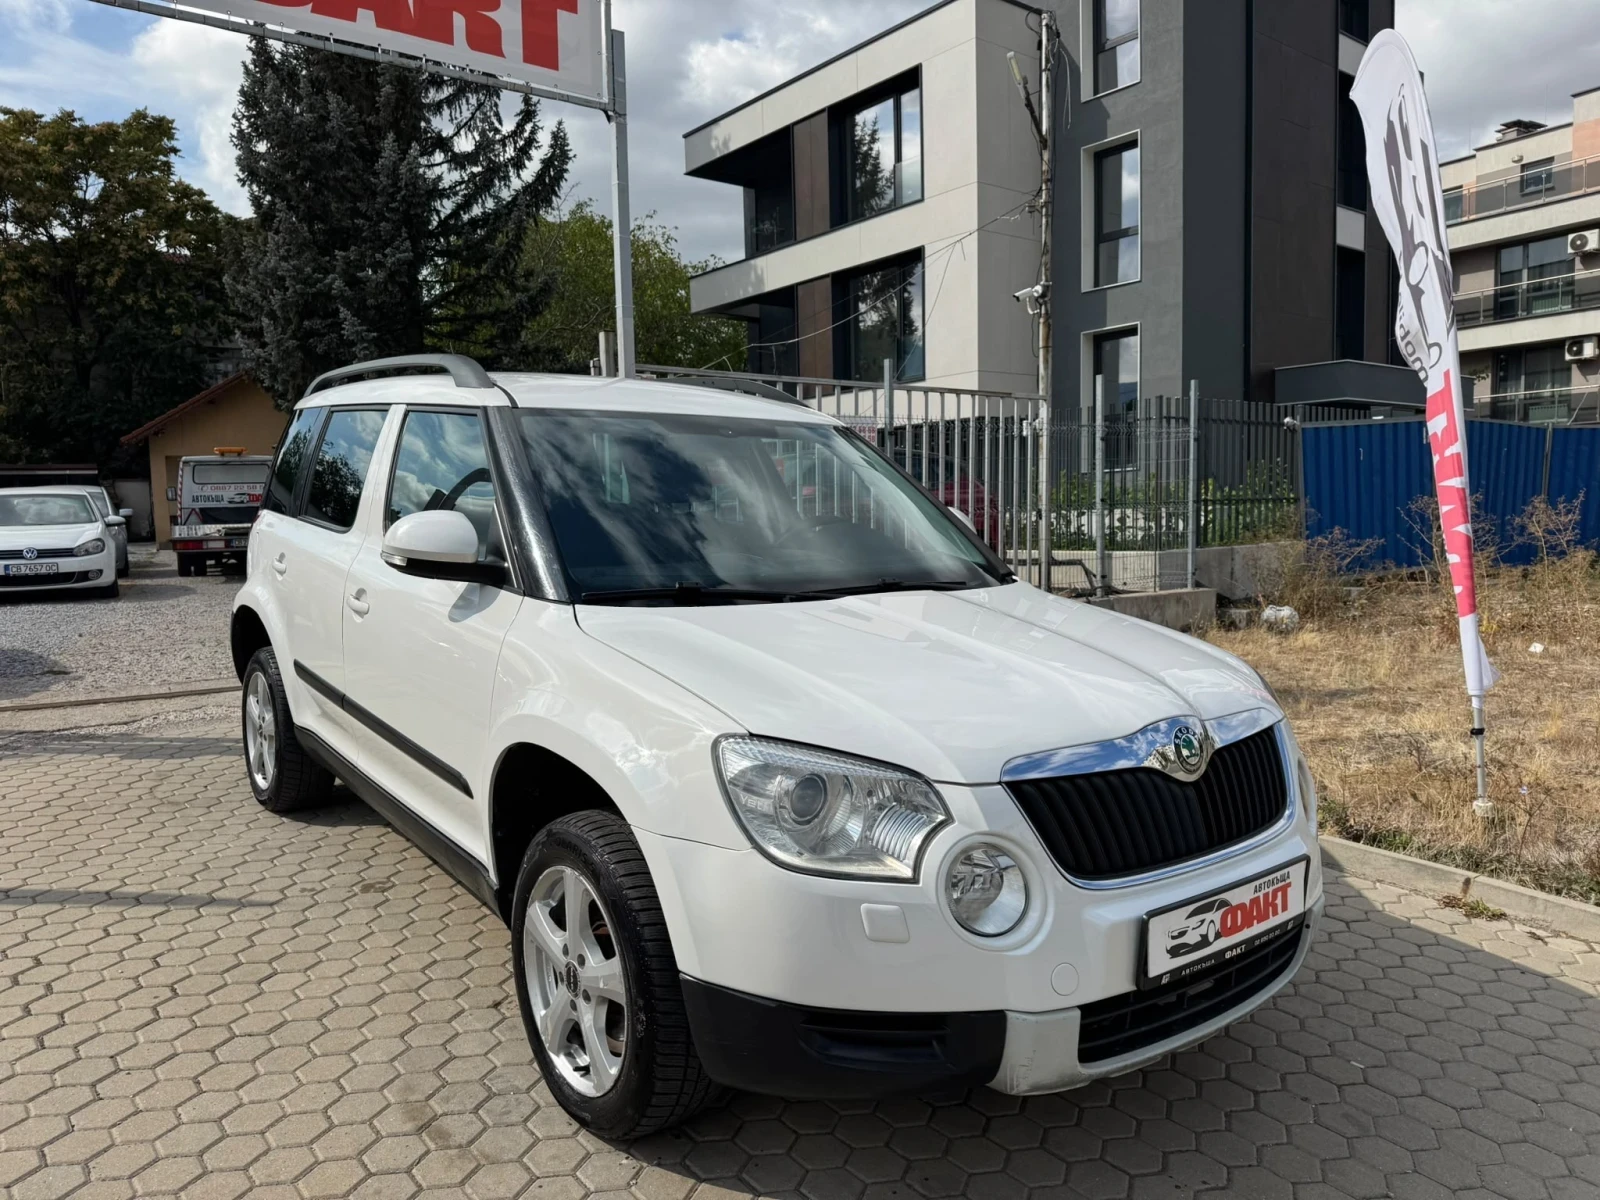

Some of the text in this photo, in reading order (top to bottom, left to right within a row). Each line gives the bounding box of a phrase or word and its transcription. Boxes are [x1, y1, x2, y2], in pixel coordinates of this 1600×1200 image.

[256, 0, 579, 72] КТ
[192, 494, 225, 503] АВТОКЪЩА
[10, 565, 22, 573] CB
[23, 564, 43, 573] 7657
[1253, 871, 1291, 895] АВТОКЪЩА
[1219, 881, 1292, 938] ФАКТ
[1181, 944, 1247, 976] АВТОКЪЩА ФАКТ
